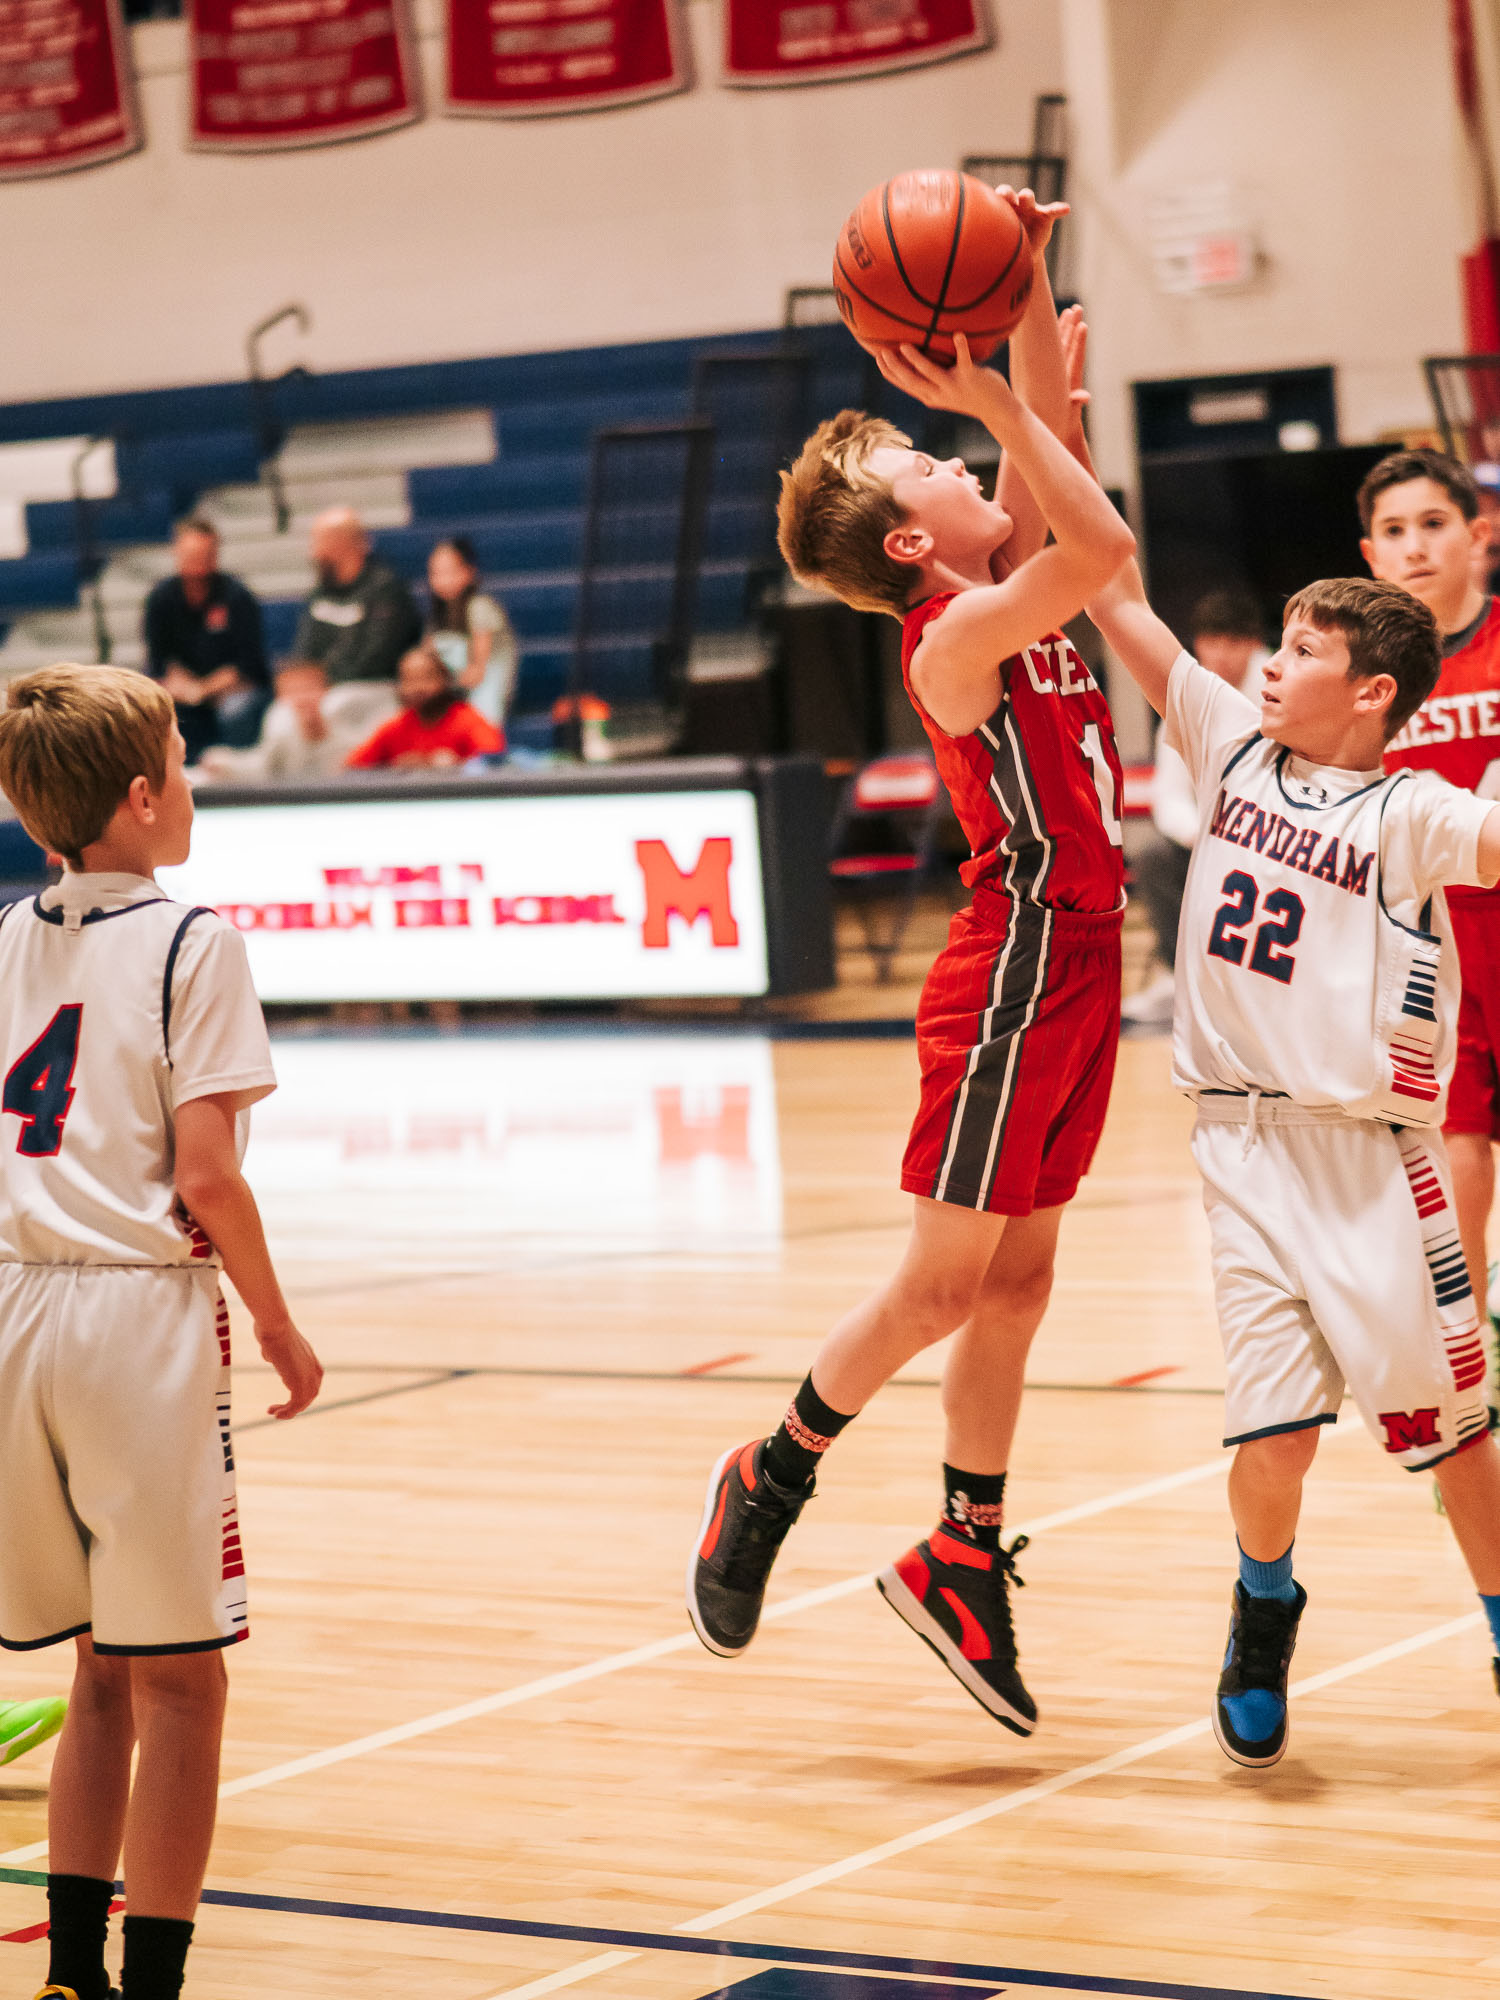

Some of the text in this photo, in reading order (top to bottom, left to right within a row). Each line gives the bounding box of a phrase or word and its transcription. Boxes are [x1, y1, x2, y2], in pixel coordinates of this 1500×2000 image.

[634, 837, 739, 948] M
[1209, 789, 1376, 897] MENDHAM
[1207, 869, 1306, 985] 22
[2, 1003, 84, 1158] 4
[1378, 1406, 1442, 1453] M
